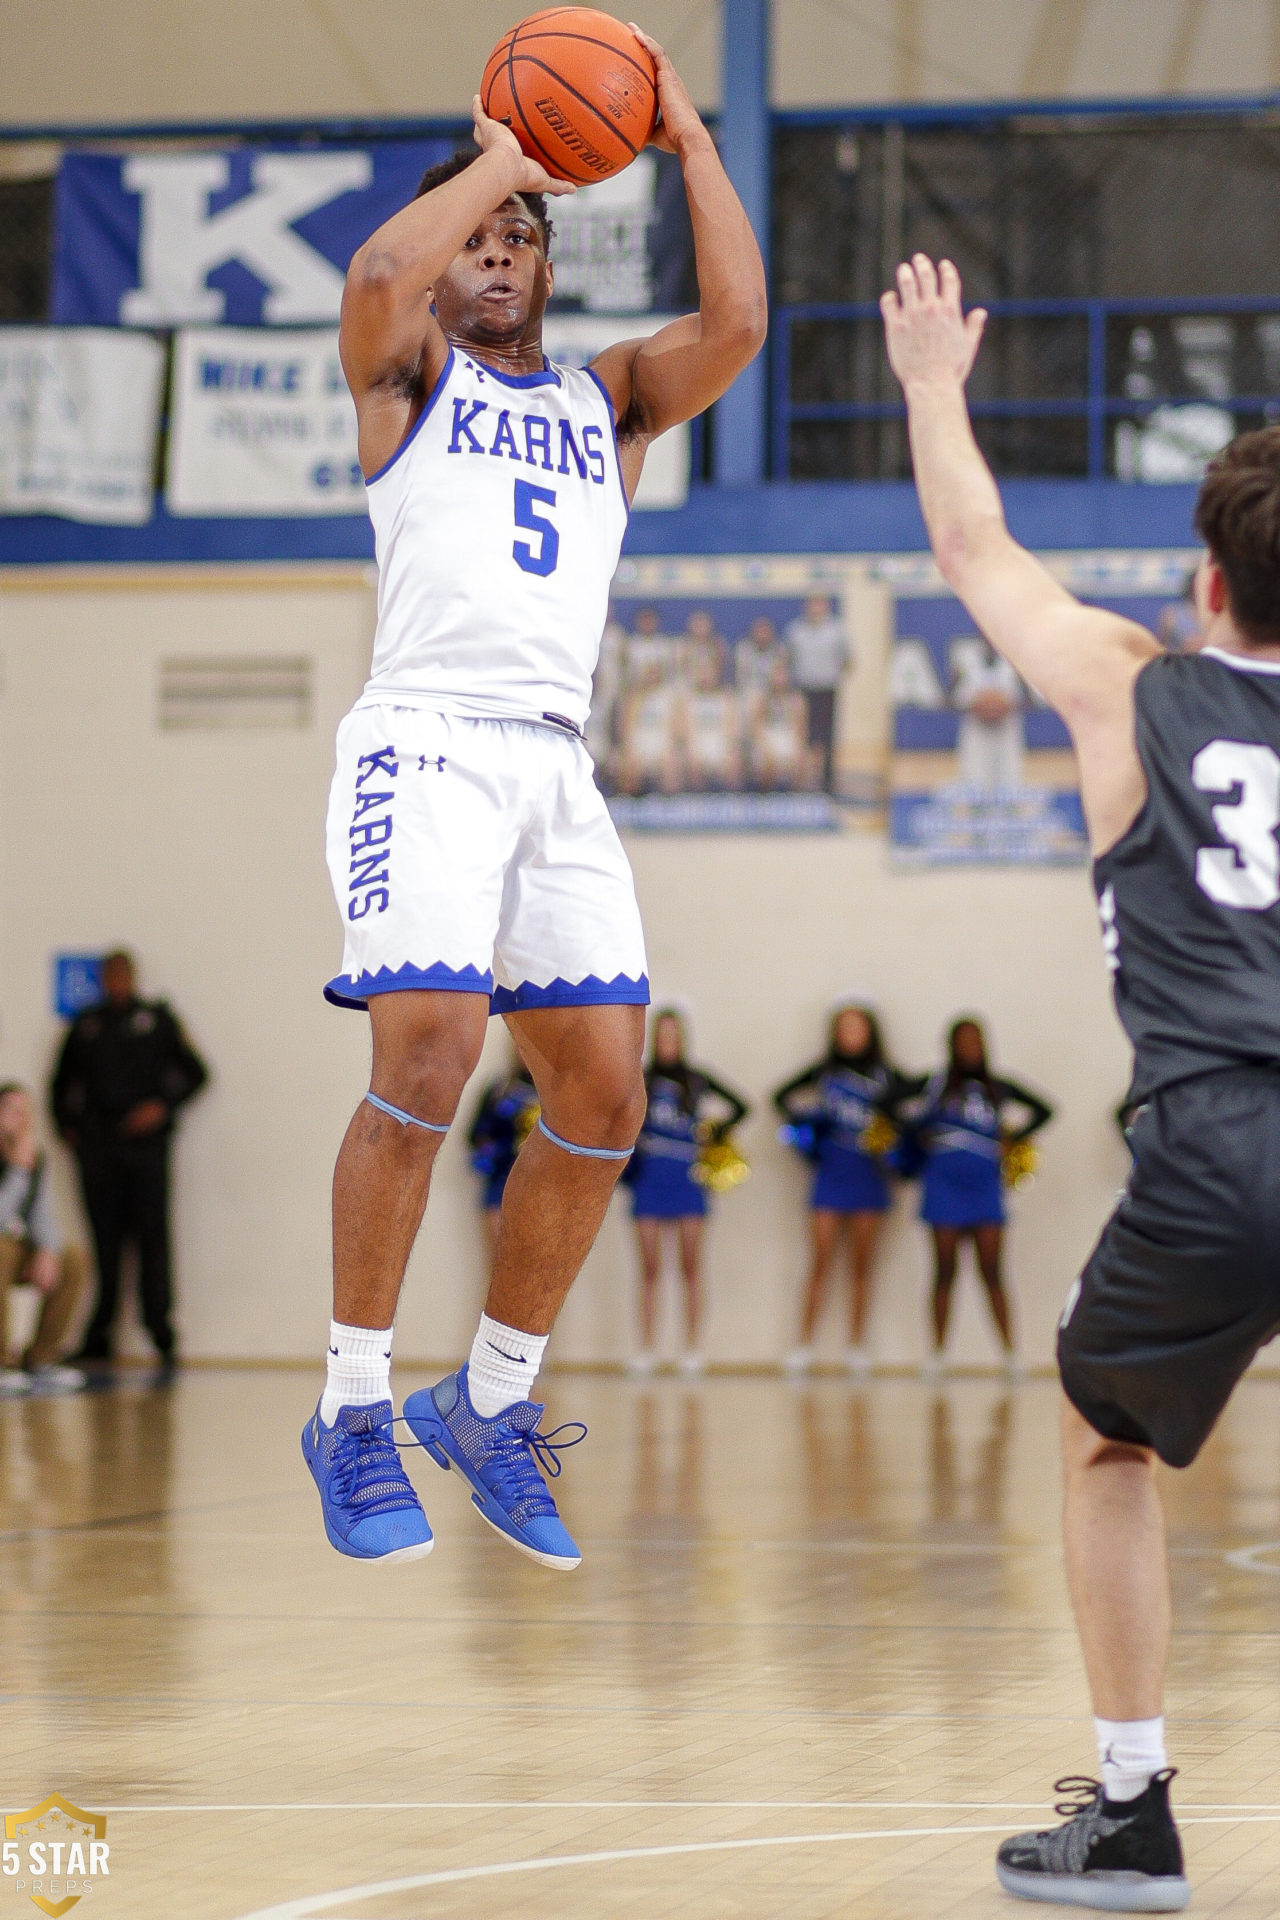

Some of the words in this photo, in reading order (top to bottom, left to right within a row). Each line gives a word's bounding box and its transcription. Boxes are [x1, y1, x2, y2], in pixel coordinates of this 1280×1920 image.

[534, 98, 616, 174] EVOLUTION
[121, 154, 372, 323] K
[448, 397, 604, 485] KARNS
[512, 477, 559, 578] 5
[348, 745, 399, 921] KARNS
[1192, 738, 1280, 911] 3
